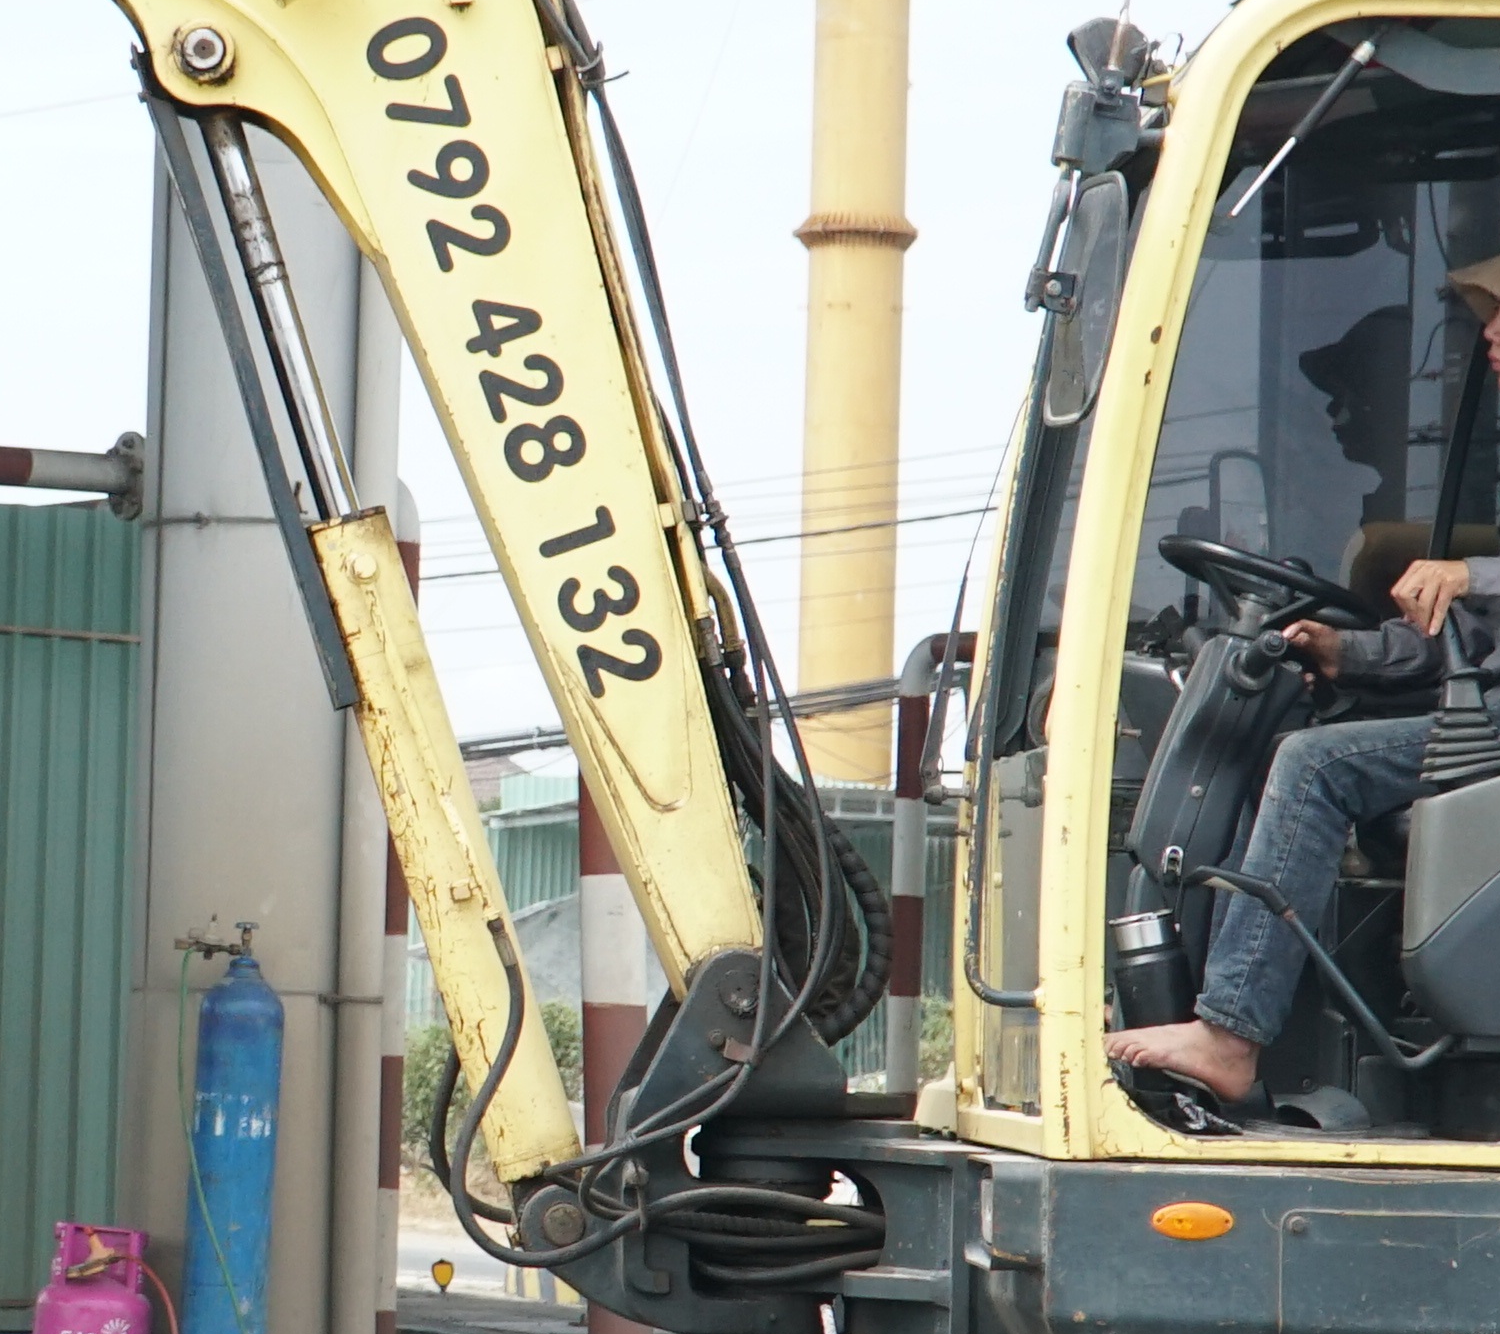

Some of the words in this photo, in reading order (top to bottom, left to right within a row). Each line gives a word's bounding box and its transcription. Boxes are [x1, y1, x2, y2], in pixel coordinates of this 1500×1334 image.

[366, 17, 511, 273] 0792
[465, 299, 586, 483] 428
[540, 505, 662, 699] 132
